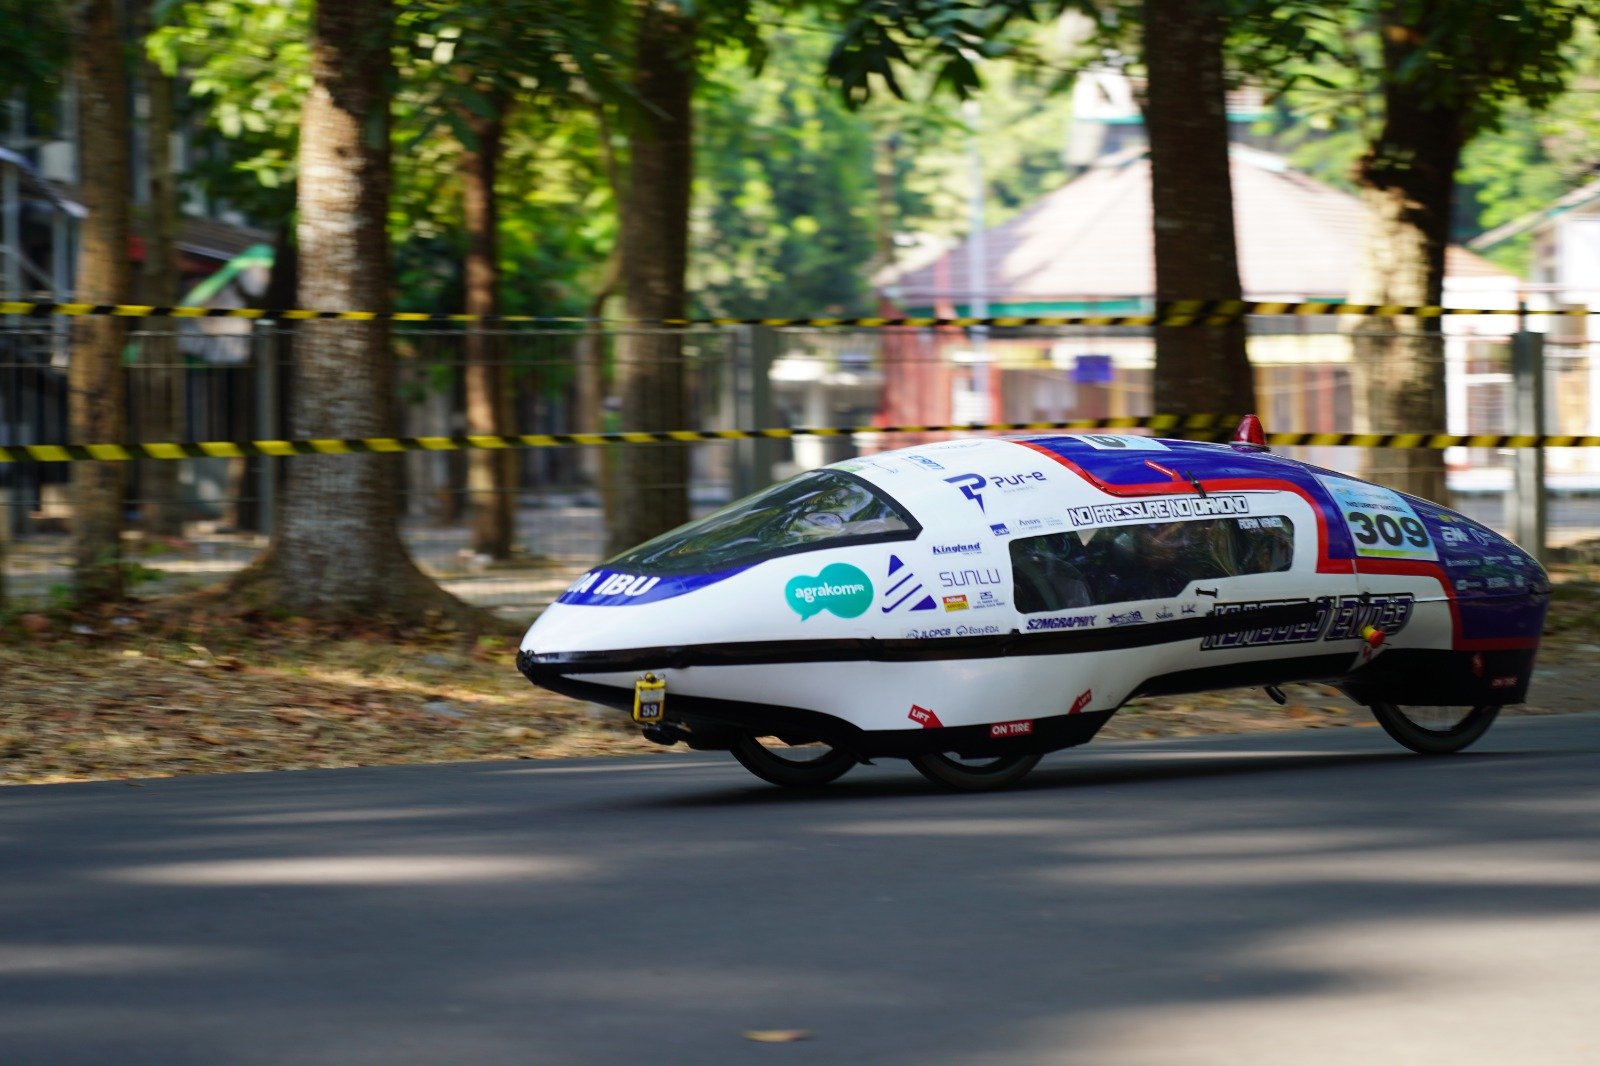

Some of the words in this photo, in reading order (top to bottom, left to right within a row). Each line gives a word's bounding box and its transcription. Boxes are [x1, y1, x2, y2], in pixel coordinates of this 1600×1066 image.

[1067, 506, 1095, 526] NO
[1092, 500, 1170, 523] PRESSURE
[1167, 499, 1192, 517] NO
[1349, 511, 1429, 548] 309
[932, 542, 981, 554] Kingland
[939, 568, 1001, 587] SUNLU
[593, 573, 661, 597] IBU
[968, 625, 1000, 636] EasyEDA
[642, 704, 658, 717] 53
[911, 709, 931, 723] LIFT
[992, 724, 1008, 736] ON
[1009, 723, 1031, 734] TIRE
